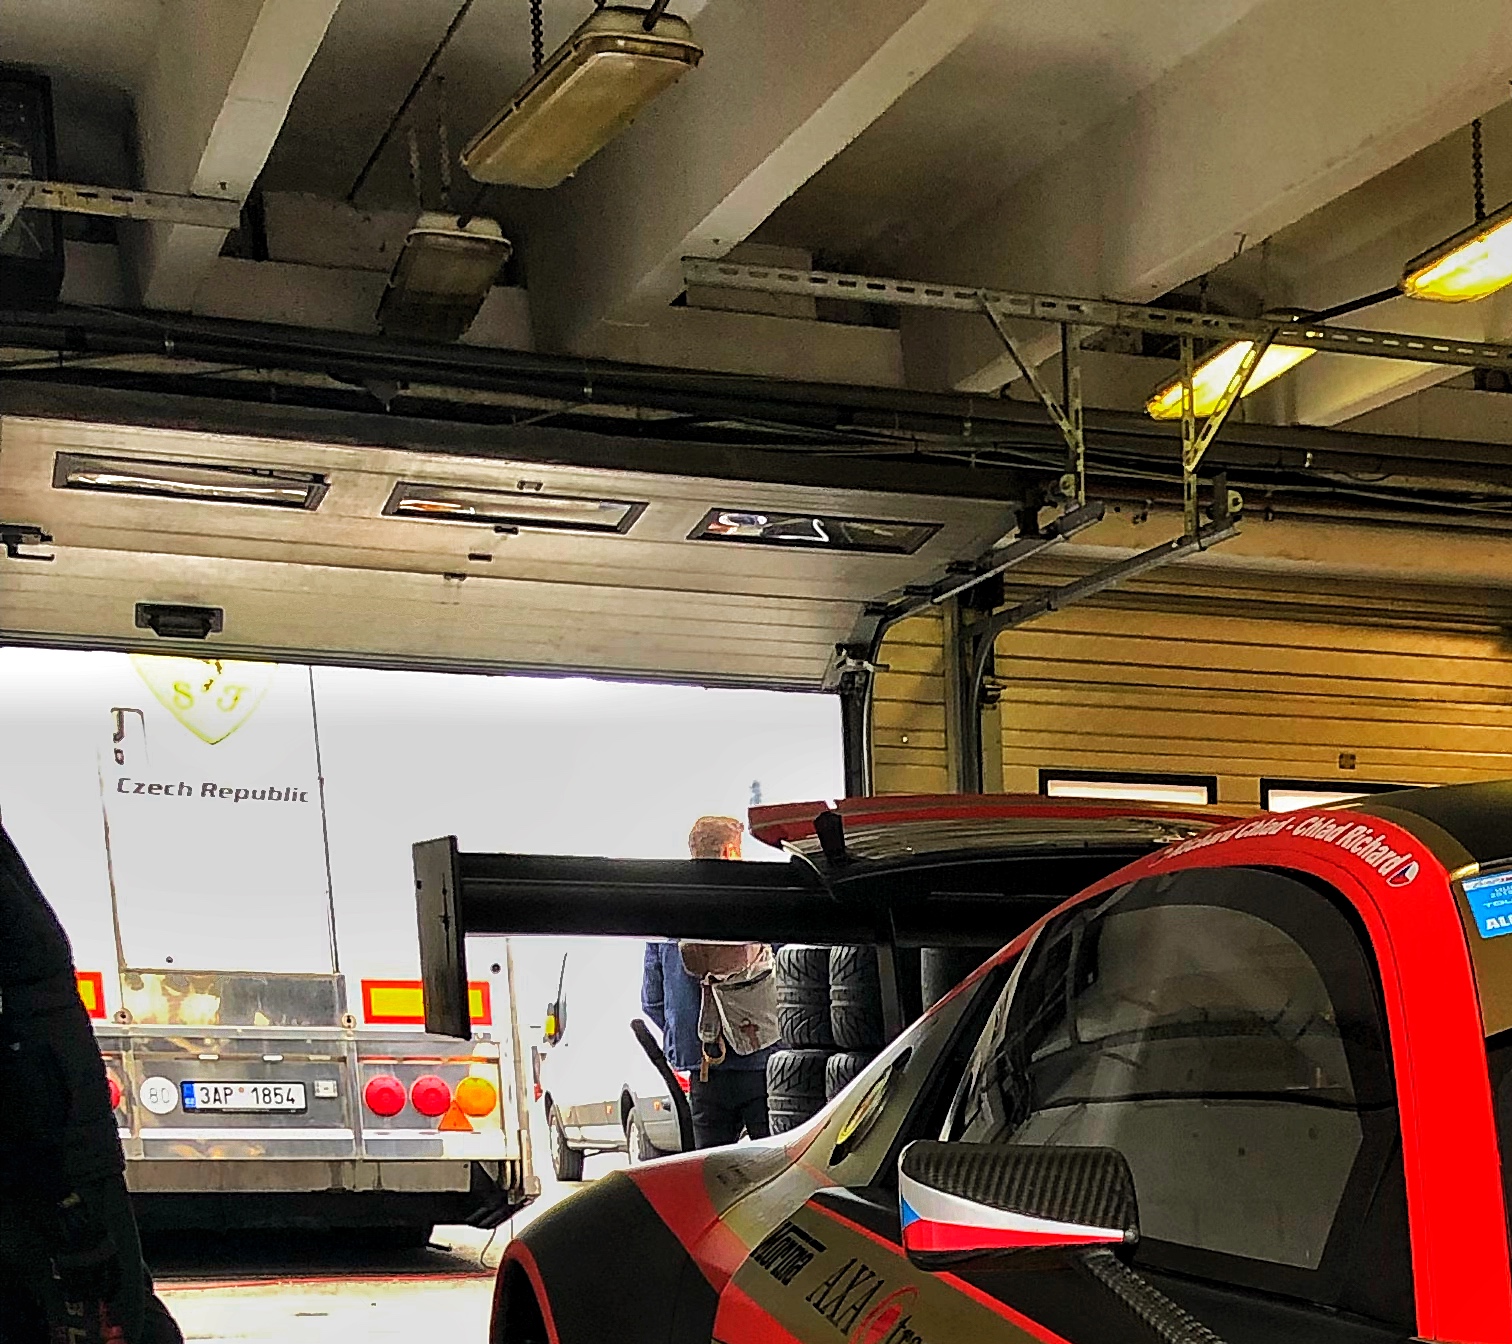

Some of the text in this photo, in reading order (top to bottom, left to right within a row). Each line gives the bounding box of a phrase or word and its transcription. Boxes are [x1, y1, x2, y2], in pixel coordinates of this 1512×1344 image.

[116, 777, 309, 803] Czech Republic
[1291, 815, 1350, 844] Chlad
[1334, 824, 1412, 877] Richard
[199, 1086, 234, 1105] 3AP
[250, 1086, 296, 1105] 1854
[804, 1257, 885, 1336] AXA
